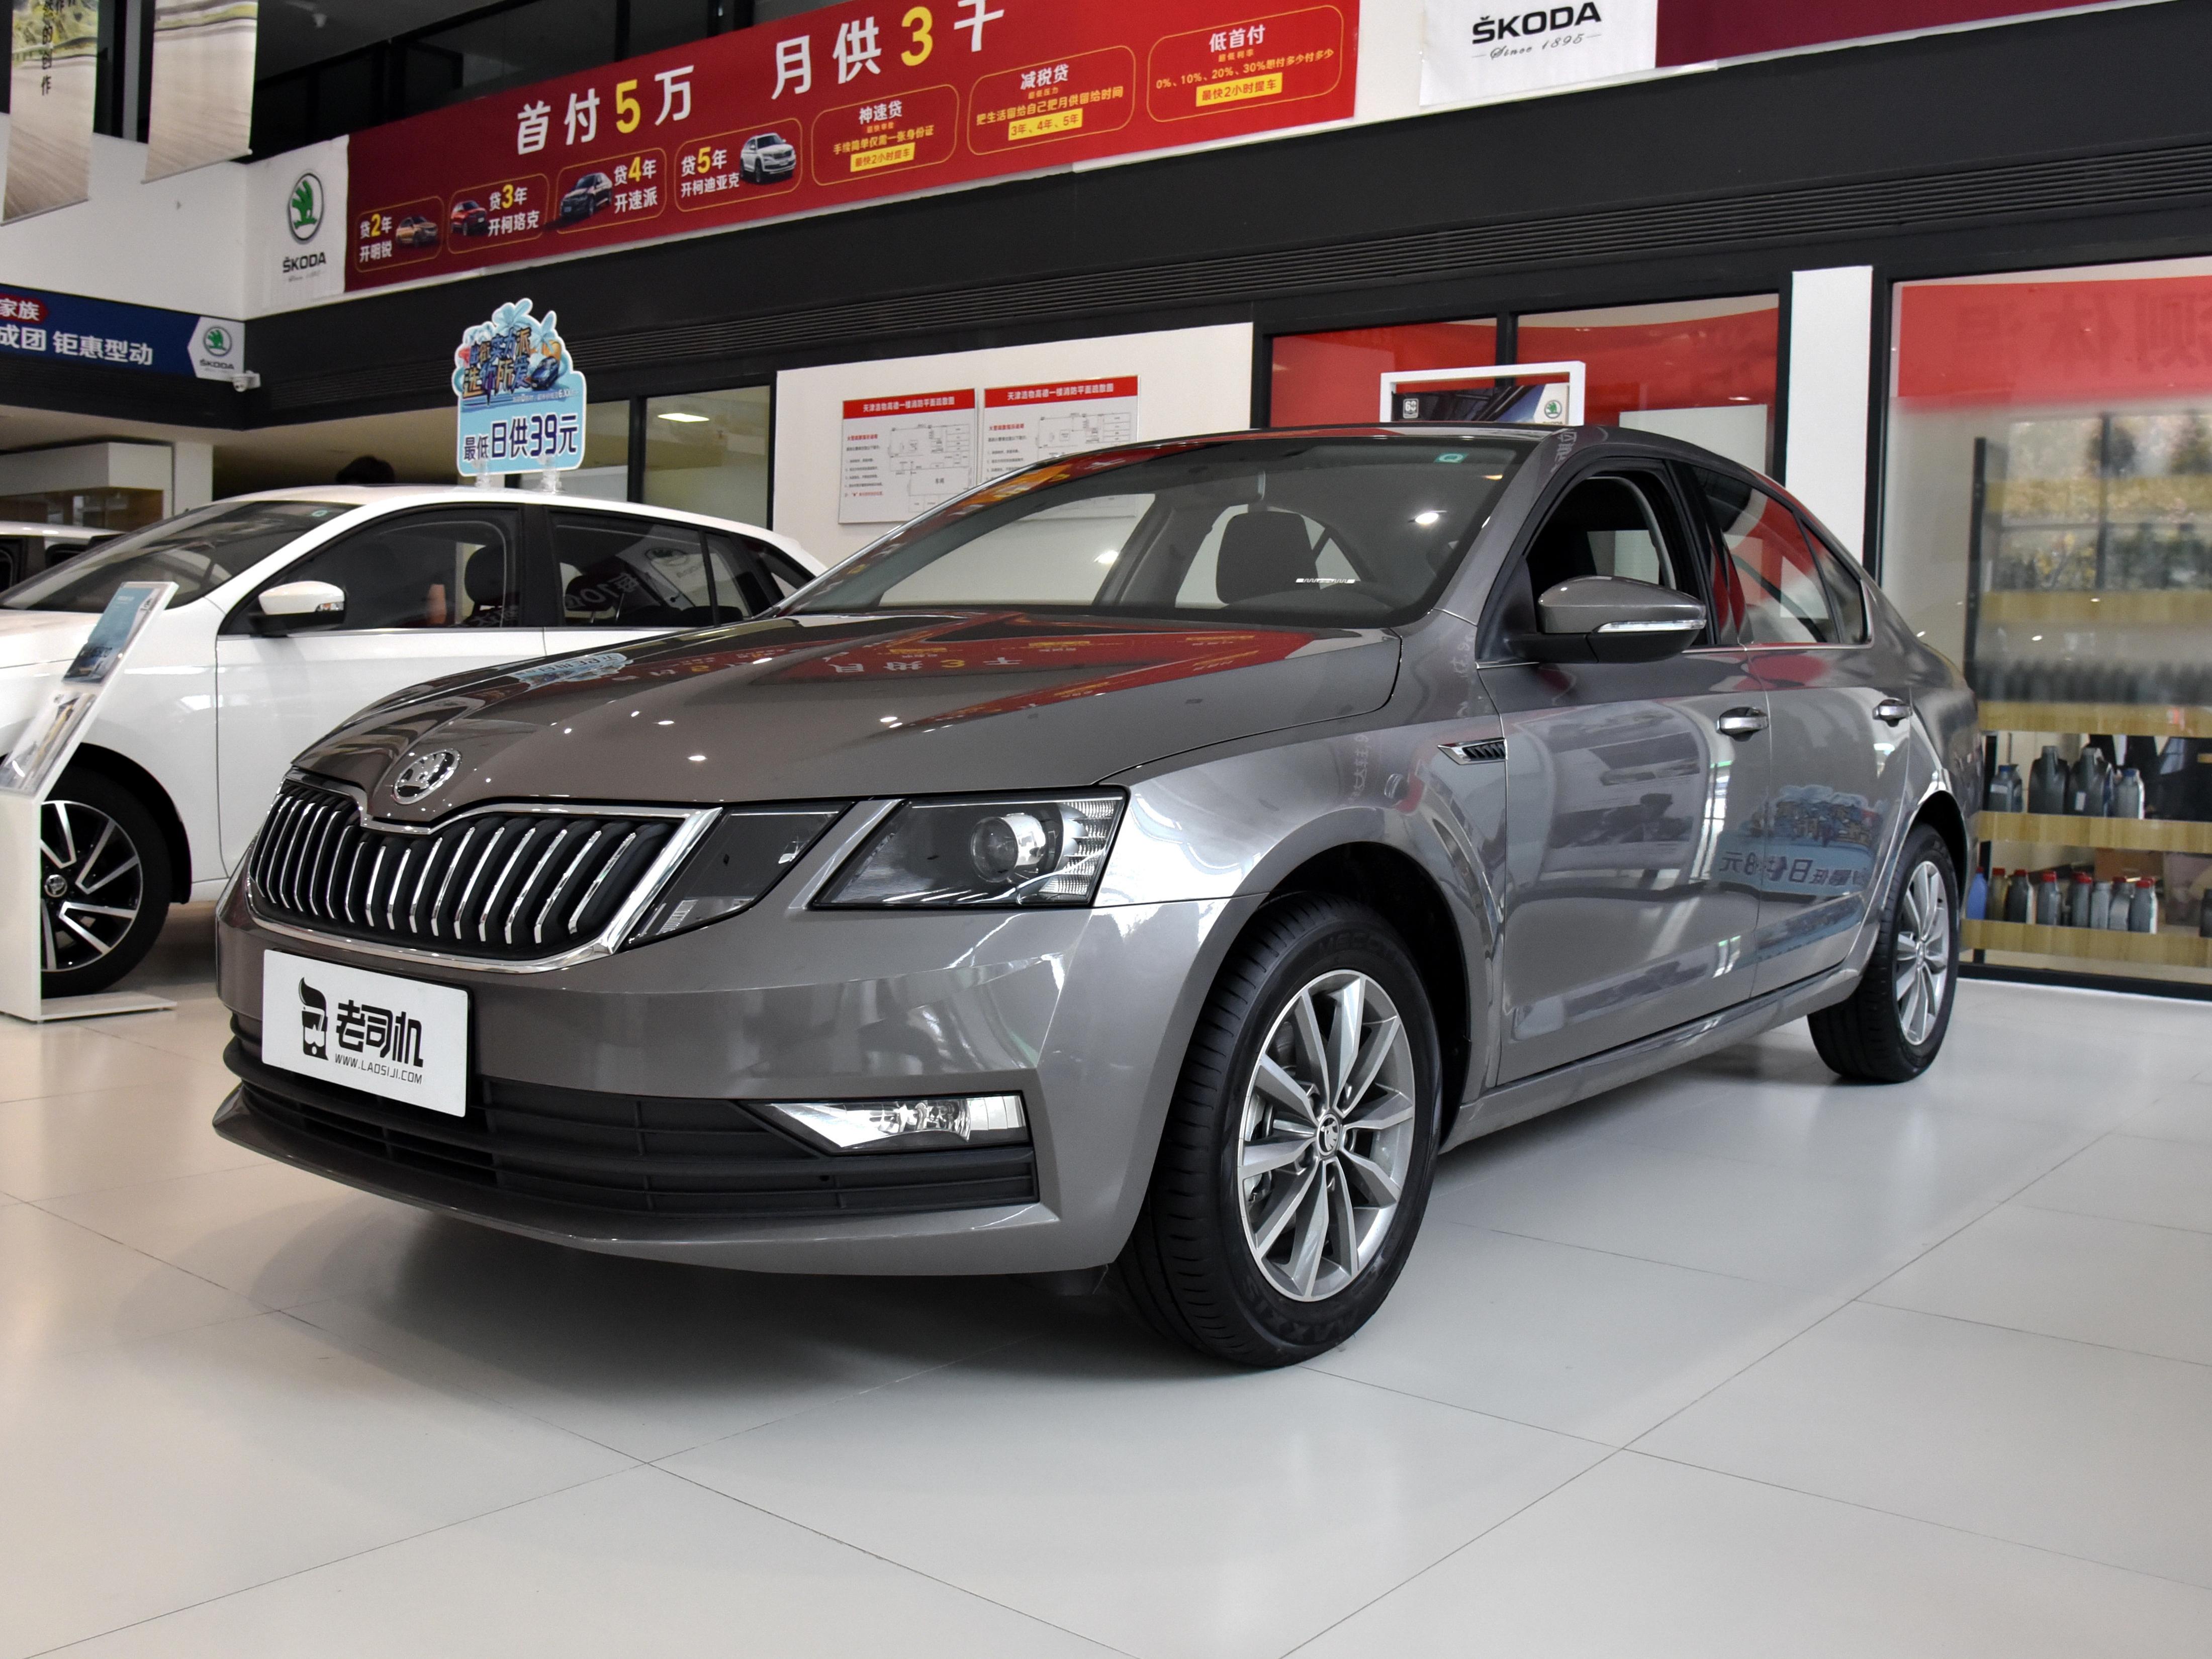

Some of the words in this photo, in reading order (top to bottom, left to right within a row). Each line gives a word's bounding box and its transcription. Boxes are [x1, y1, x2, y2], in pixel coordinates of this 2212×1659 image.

[1472, 2, 1602, 44] ŠKODA
[1209, 24, 1265, 52] 低首付
[1490, 47, 1532, 60] Since
[1541, 34, 1585, 49] 1895
[517, 65, 694, 155] 首付5万
[771, 0, 1004, 100] 月供3千
[1020, 64, 1069, 90] 减税贷
[1202, 79, 1277, 101] 最快2小时提车
[858, 100, 902, 125] 神速贷
[976, 86, 1124, 126] 把生活留给自己把月供留给时间
[1011, 114, 1079, 136] 3年、4年、5年
[614, 157, 657, 187] 贷4年
[681, 147, 727, 177] 贷5年
[489, 184, 528, 211] 贷3年
[681, 172, 740, 198] 开柯迪亚克
[614, 187, 658, 214] 开速派
[360, 214, 392, 239] 贷2年
[488, 210, 540, 237] 开柯珞克
[283, 252, 326, 273] ŠKODA
[359, 240, 392, 262] 开明锐
[0, 298, 40, 321] 家族
[0, 324, 46, 351] 成团
[52, 331, 153, 365] 钜惠型动
[464, 414, 578, 459] 最低日供39元
[336, 999, 423, 1067] 老司机
[335, 1053, 422, 1084] WWW.LAOSIJI.COM
